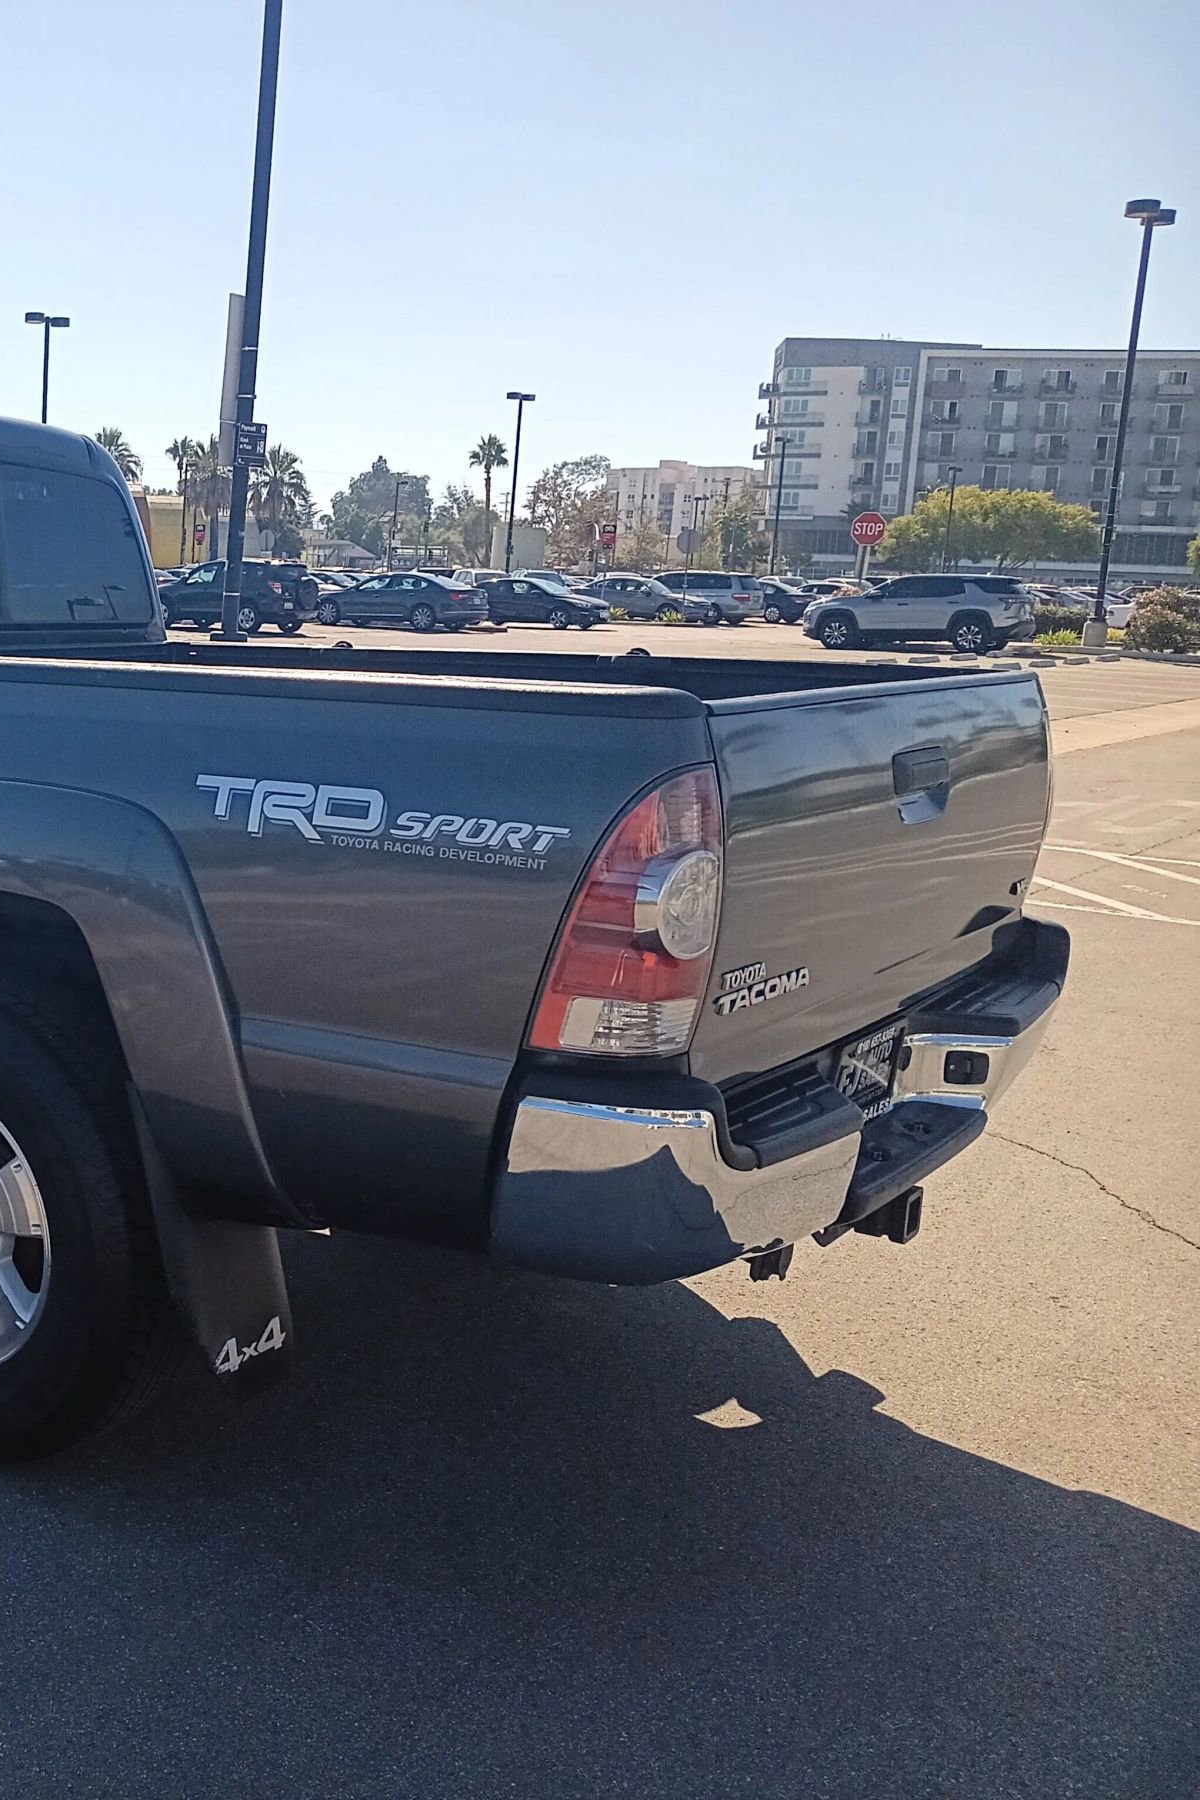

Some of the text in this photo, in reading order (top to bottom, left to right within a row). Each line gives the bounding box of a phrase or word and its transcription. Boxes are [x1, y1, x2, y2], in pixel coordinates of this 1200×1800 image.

[853, 522, 884, 535] STOP
[195, 773, 572, 855] TRD SPORT
[330, 833, 547, 871] TOYOTA RACING DEVELOPMENT
[714, 966, 810, 1016] TACOMA
[721, 961, 767, 990] TOYOTA
[867, 1040, 894, 1066] AUTO
[213, 1315, 287, 1375] 4x4
